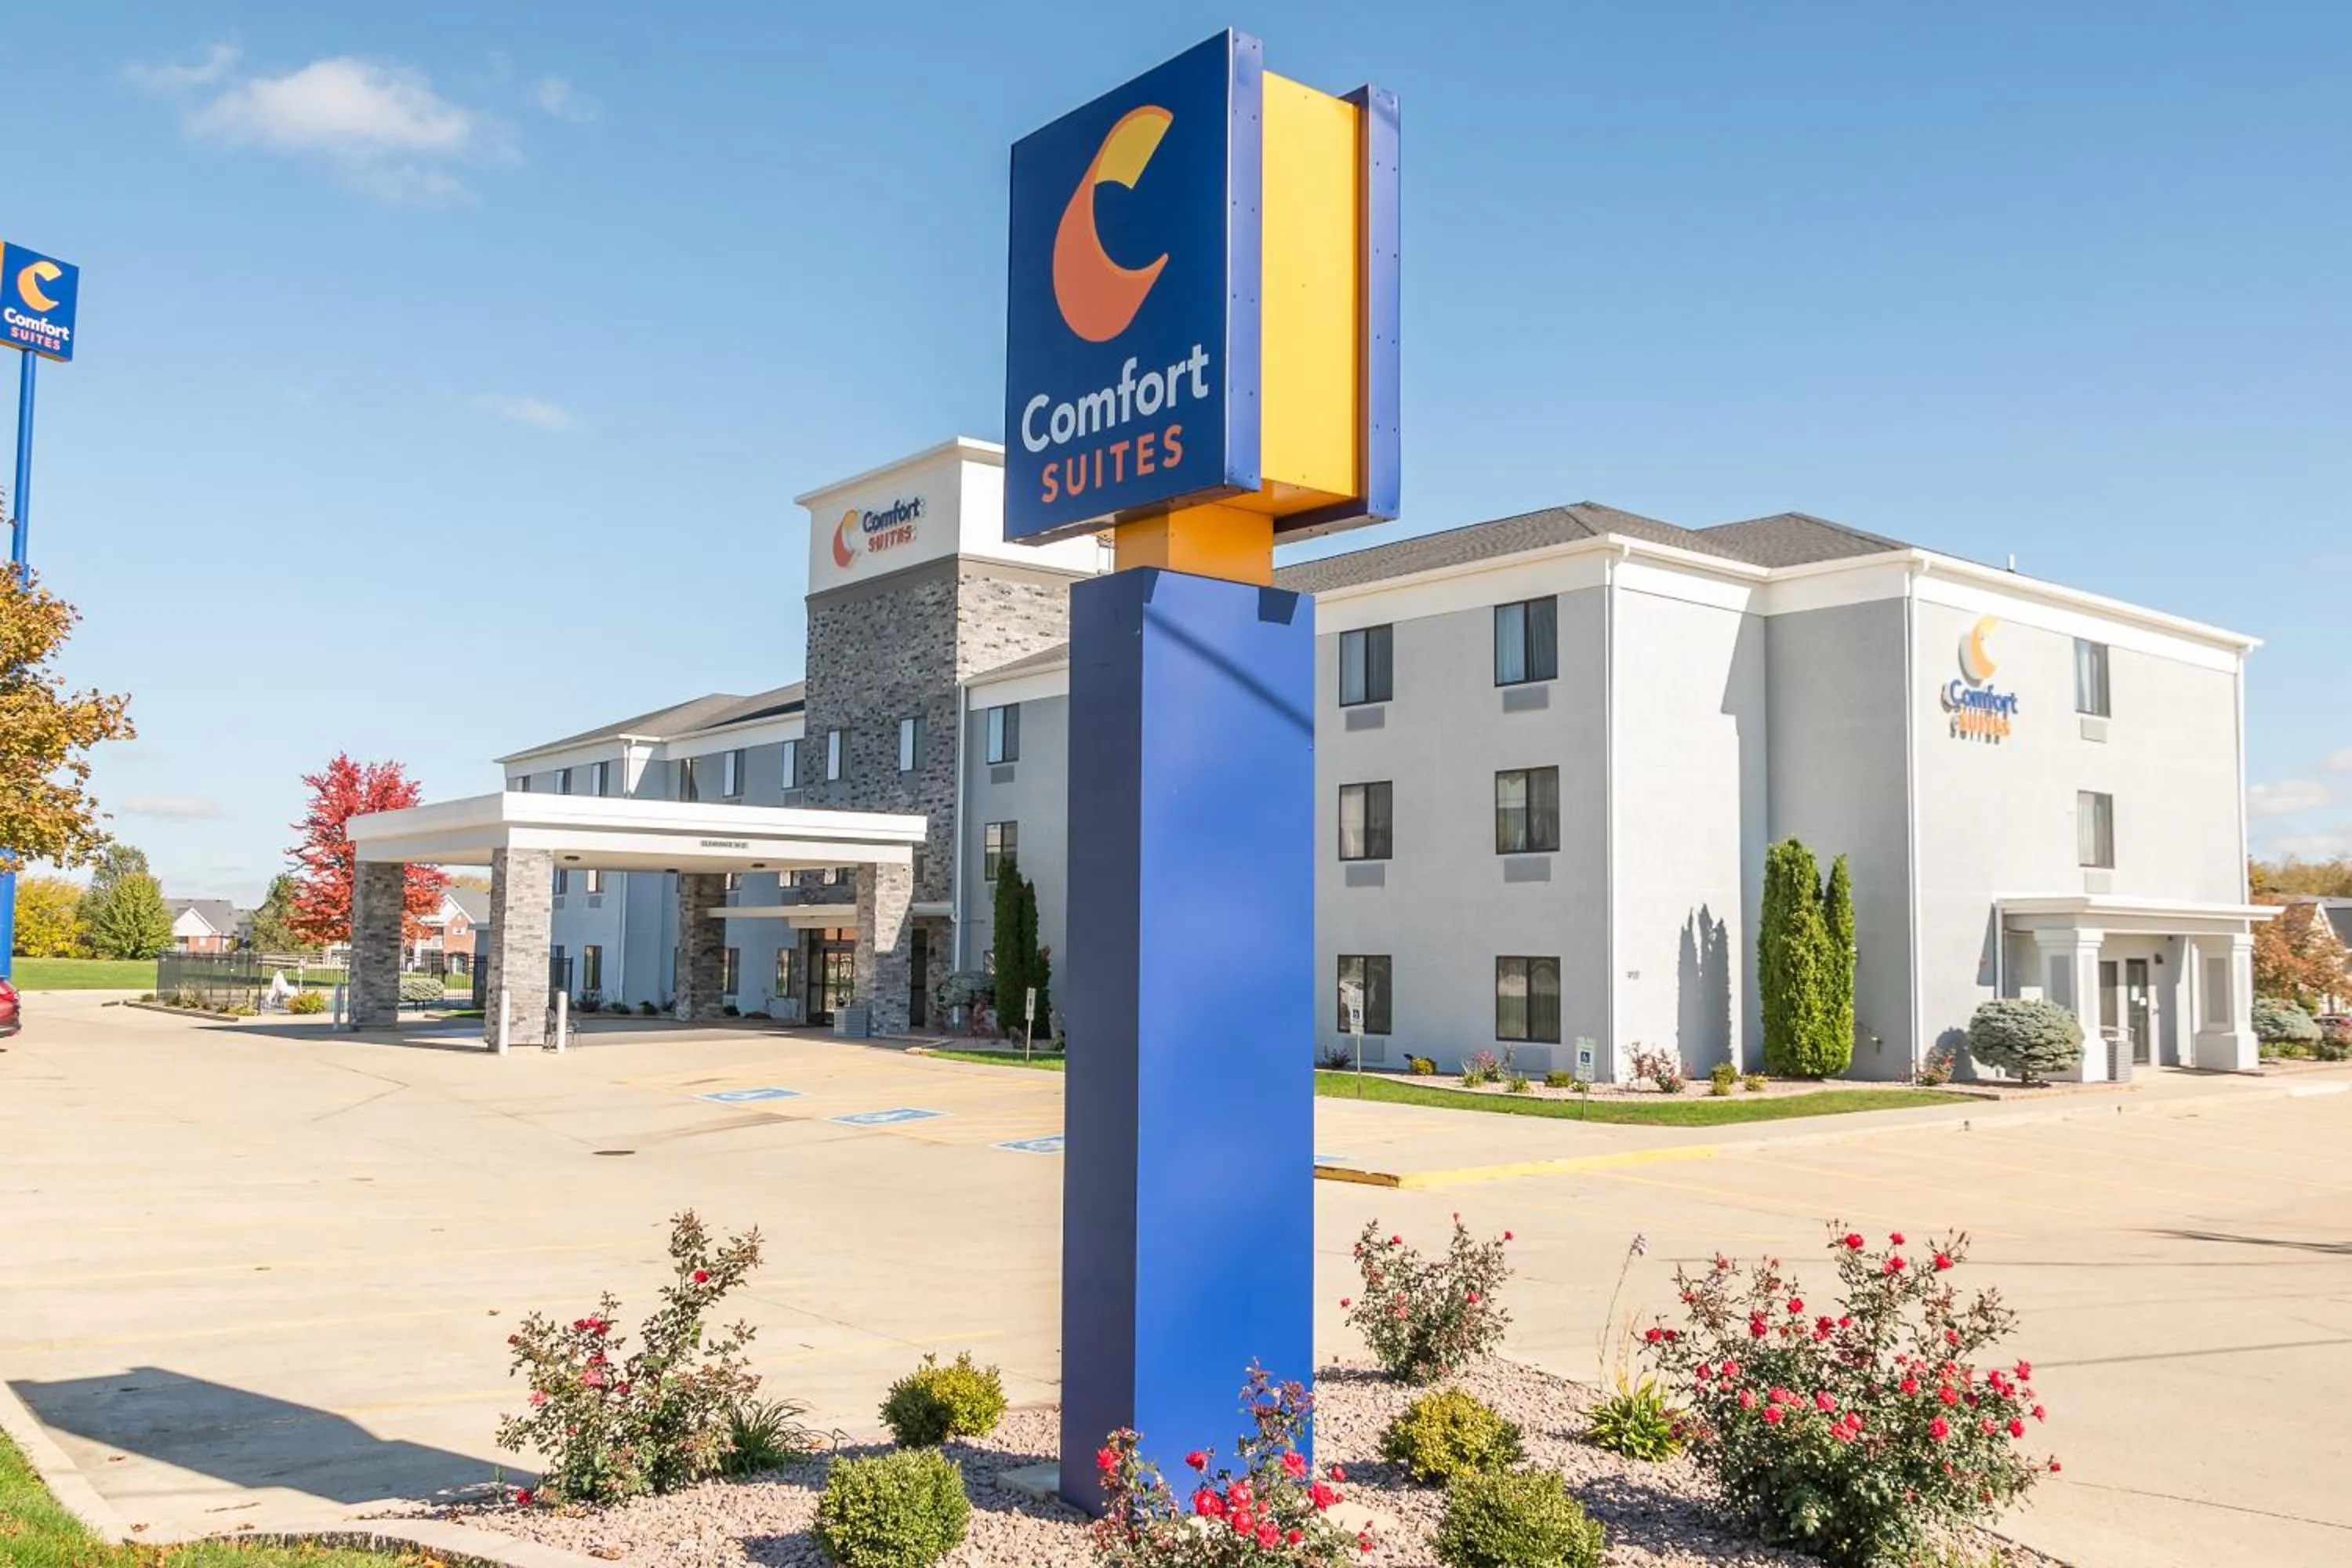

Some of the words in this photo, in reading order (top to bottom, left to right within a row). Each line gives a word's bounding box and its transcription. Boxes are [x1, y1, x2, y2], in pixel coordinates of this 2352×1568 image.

[3, 307, 70, 341] Comfort
[10, 326, 61, 351] SUITES
[1022, 343, 1209, 452] Comfort
[1040, 424, 1183, 503] SUITES
[863, 496, 921, 534] Comfort
[868, 524, 914, 553] SUITES
[1949, 679, 2019, 715] Comfort
